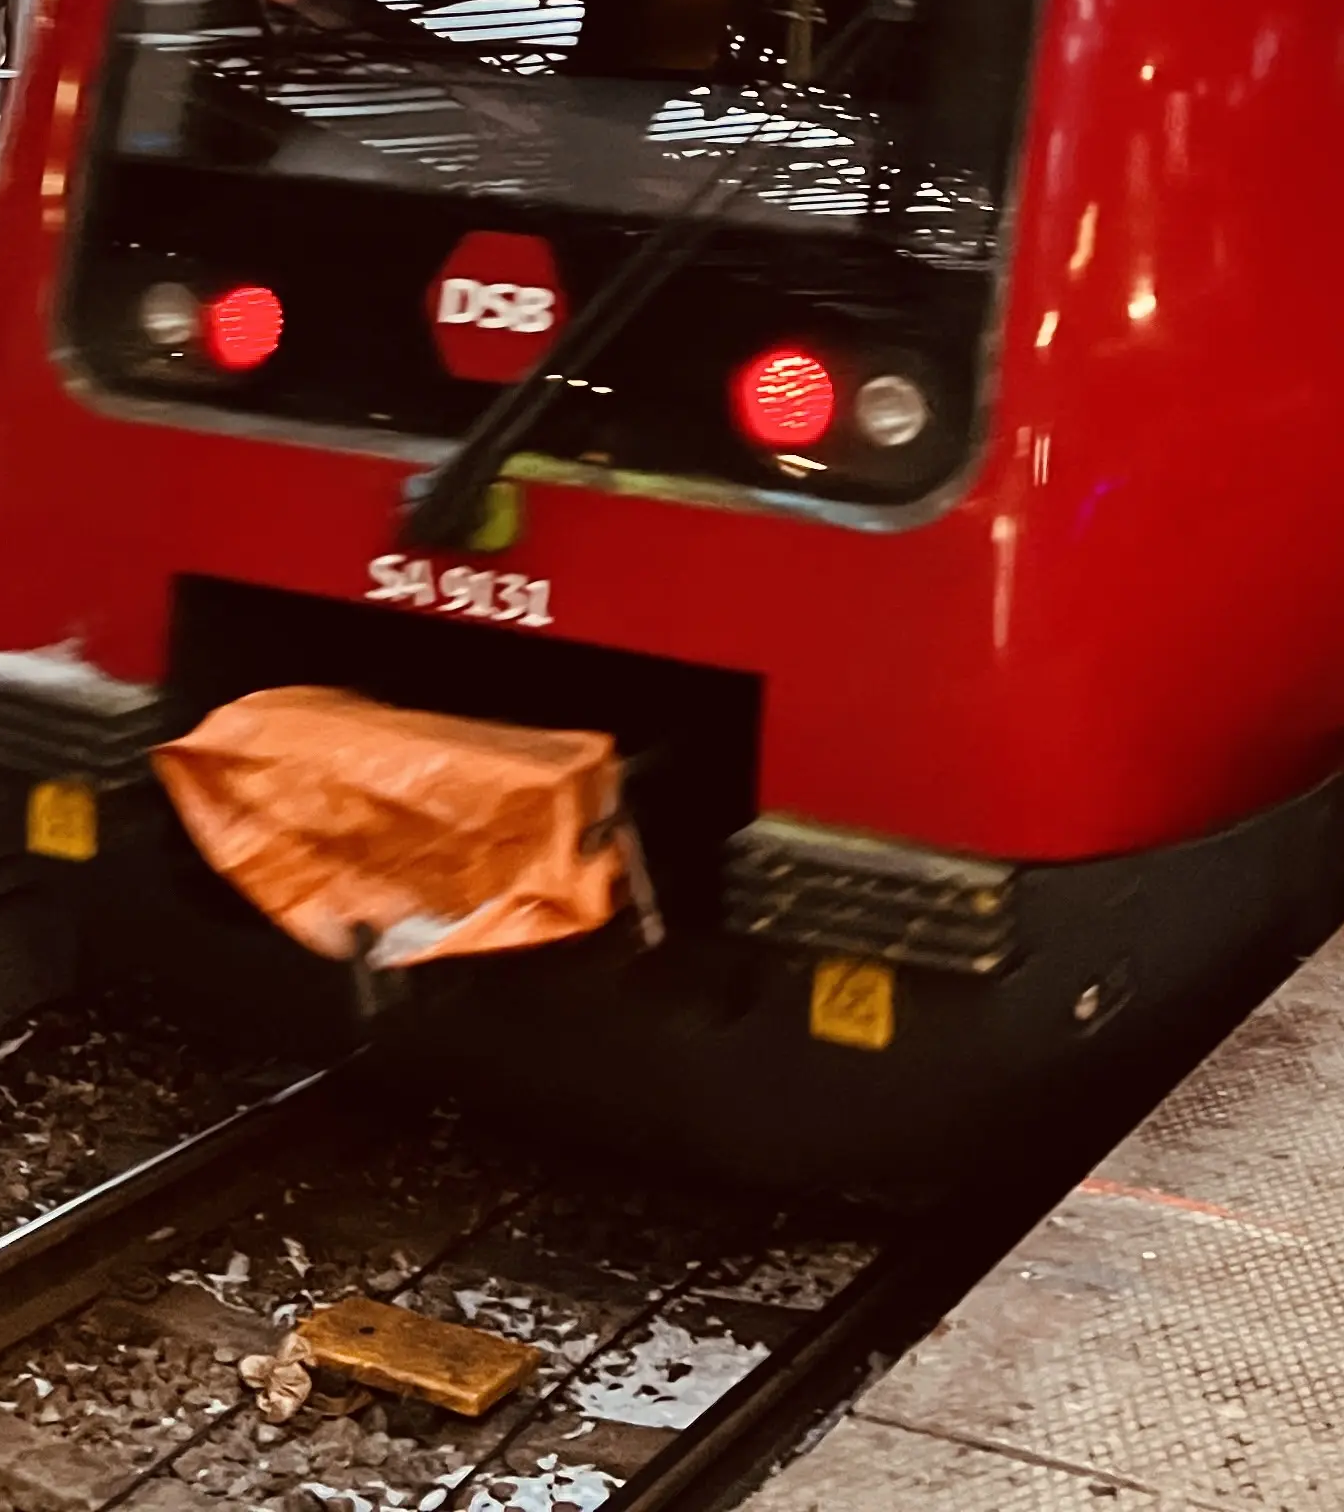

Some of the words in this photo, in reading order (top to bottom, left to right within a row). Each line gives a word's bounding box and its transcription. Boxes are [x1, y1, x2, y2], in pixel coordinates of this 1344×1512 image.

[436, 277, 556, 333] DSB
[364, 553, 436, 607] SA
[436, 565, 555, 628] 9131
